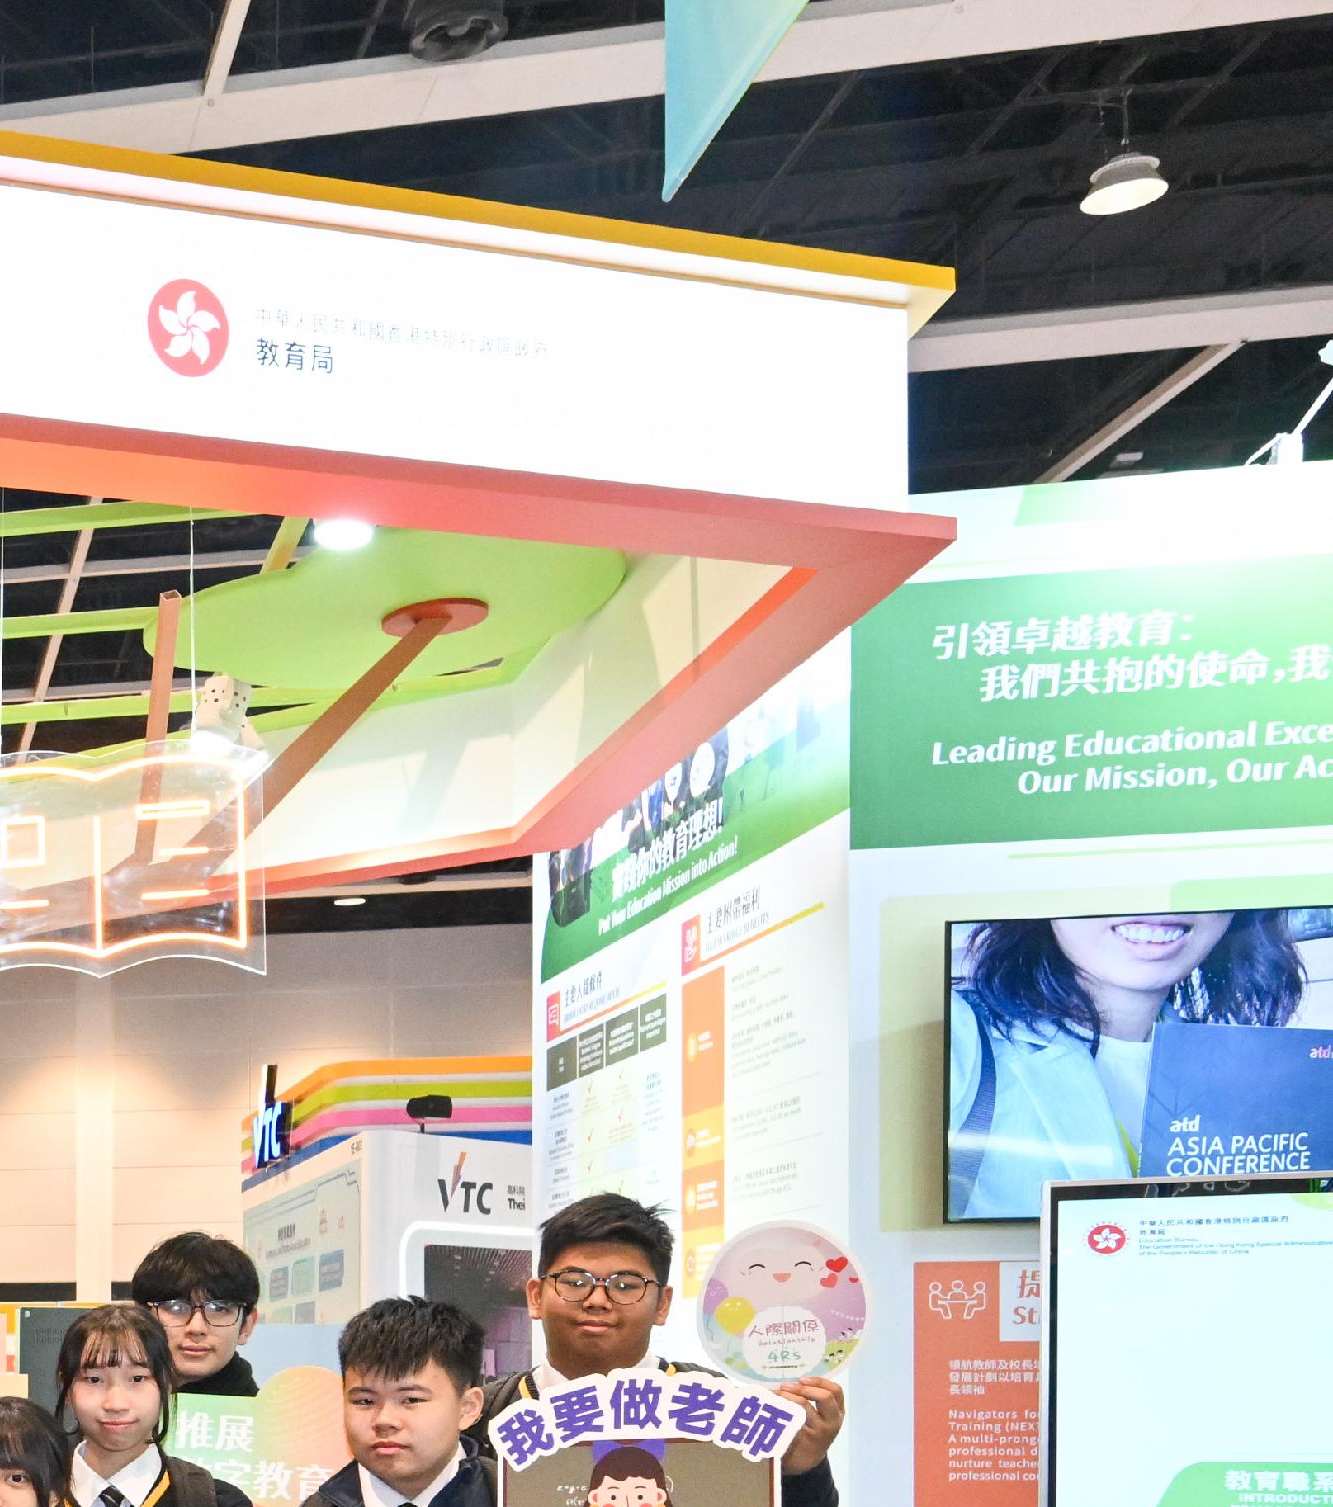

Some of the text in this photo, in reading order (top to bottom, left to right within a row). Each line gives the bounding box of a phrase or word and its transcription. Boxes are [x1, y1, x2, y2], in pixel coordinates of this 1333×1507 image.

[257, 338, 334, 373] 教育局
[933, 737, 1057, 766] Leading
[1065, 720, 1257, 758] Educational
[1018, 770, 1078, 794] Our
[1085, 763, 1218, 789] Mission,
[1227, 758, 1289, 782] Our
[627, 887, 662, 924] Education
[663, 870, 690, 900] Mission
[691, 858, 707, 882] into
[708, 835, 738, 873] Action!
[252, 1064, 282, 1168] VTC
[1170, 1114, 1201, 1132] atd
[1168, 1132, 1309, 1156] ASIA PACIFIC
[1166, 1151, 1312, 1176] CONFERENCE
[437, 1151, 494, 1215] VTC
[1013, 1305, 1041, 1325] St
[497, 1378, 794, 1466] 我要做老師
[948, 1409, 1018, 1421] Navigators
[948, 1421, 1001, 1433] Training
[176, 1410, 254, 1453] 推展
[948, 1435, 957, 1444] A
[948, 1447, 1026, 1458] professional
[948, 1459, 992, 1468] nurture
[948, 1470, 1020, 1483] professional
